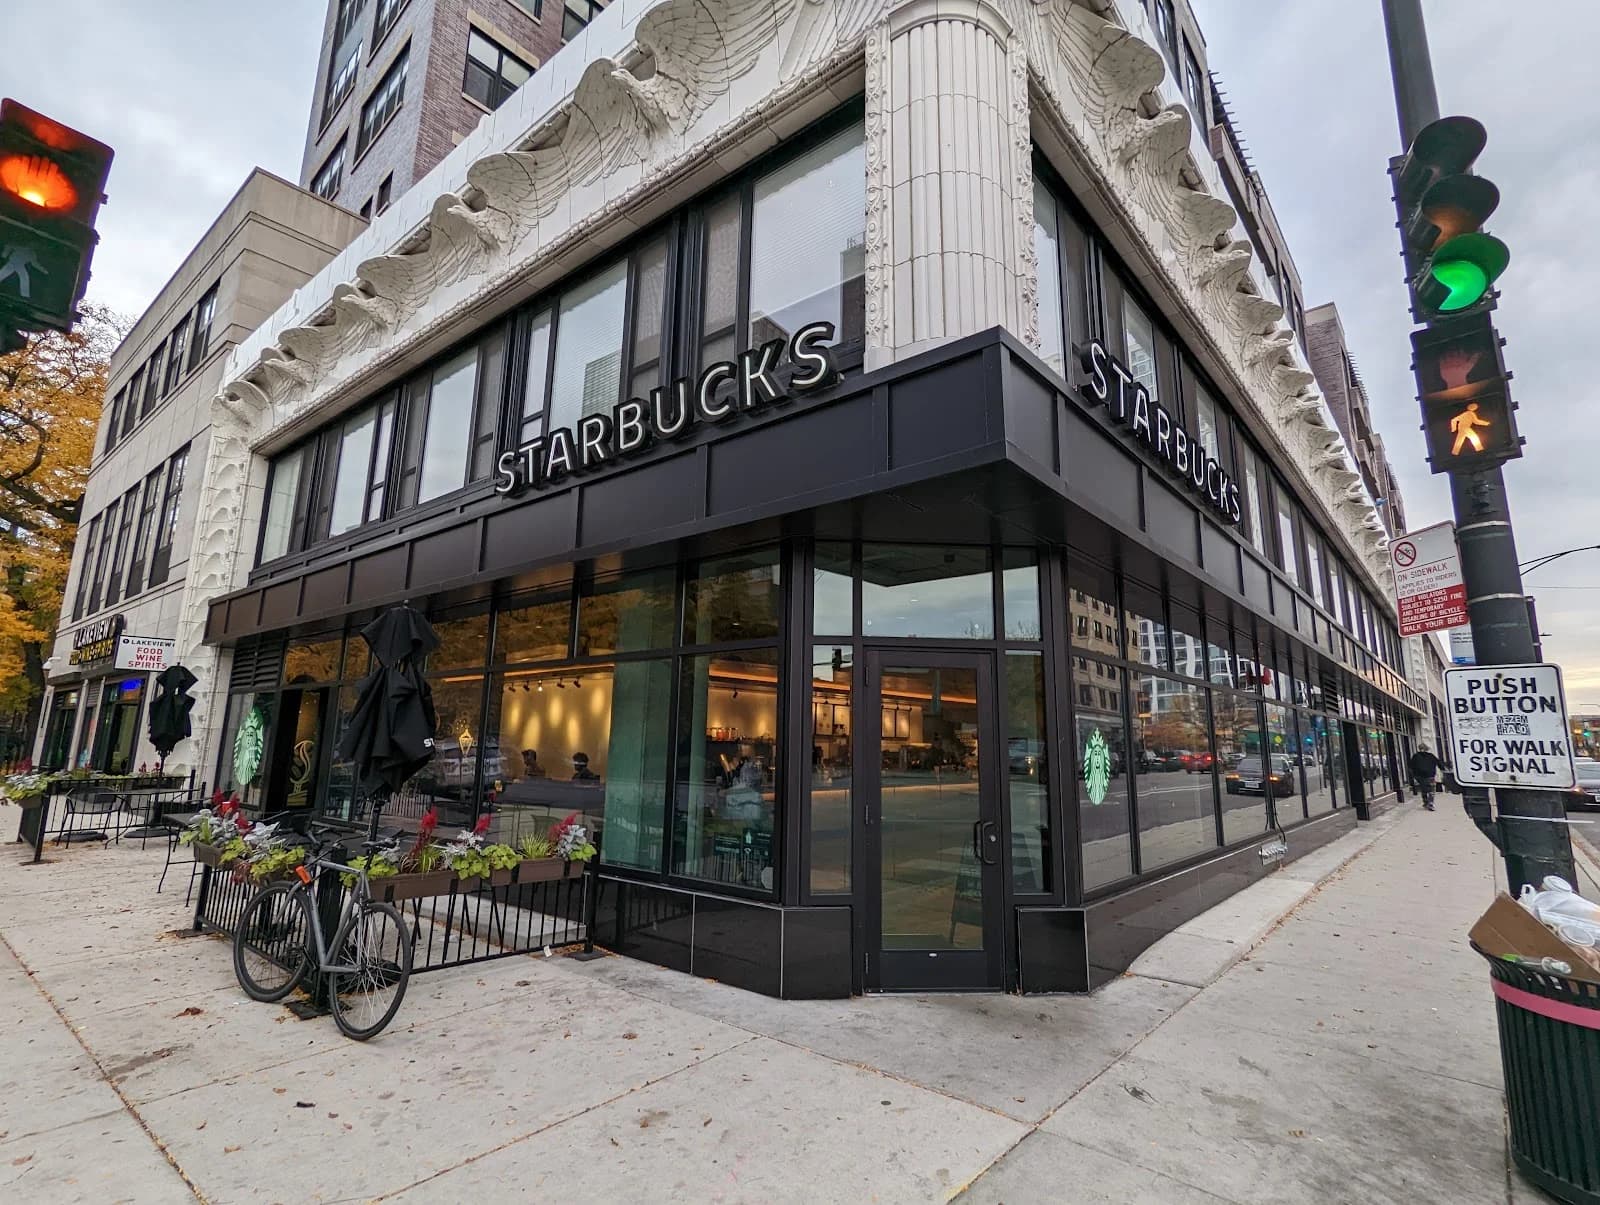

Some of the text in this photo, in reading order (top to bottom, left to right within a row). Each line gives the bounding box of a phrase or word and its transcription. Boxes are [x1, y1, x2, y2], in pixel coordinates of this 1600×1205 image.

[494, 321, 840, 497] STARBUCKS
[1082, 338, 1242, 524] STARBUCKS
[1410, 563, 1448, 579] SIDEWALK
[1435, 572, 1457, 580] RIDERS
[1401, 601, 1423, 610] SUBJECT
[1450, 592, 1463, 600] FINE
[1418, 590, 1447, 601] VIOLATORS
[1402, 614, 1428, 623] DISABLING
[1439, 606, 1461, 615] BICYCLE
[1414, 604, 1444, 615] TEMPORARY
[1403, 616, 1465, 633] WALK YOUR BIKE
[131, 639, 171, 648] LAKEVIEW
[136, 647, 163, 655] FOOD
[128, 660, 168, 670] SPIRITS
[136, 653, 163, 662] WINE
[1467, 677, 1538, 695] PUSH
[1453, 696, 1558, 714] BUTTON
[1459, 739, 1566, 756] FOR WALK
[1469, 756, 1556, 775] SIGNAL
